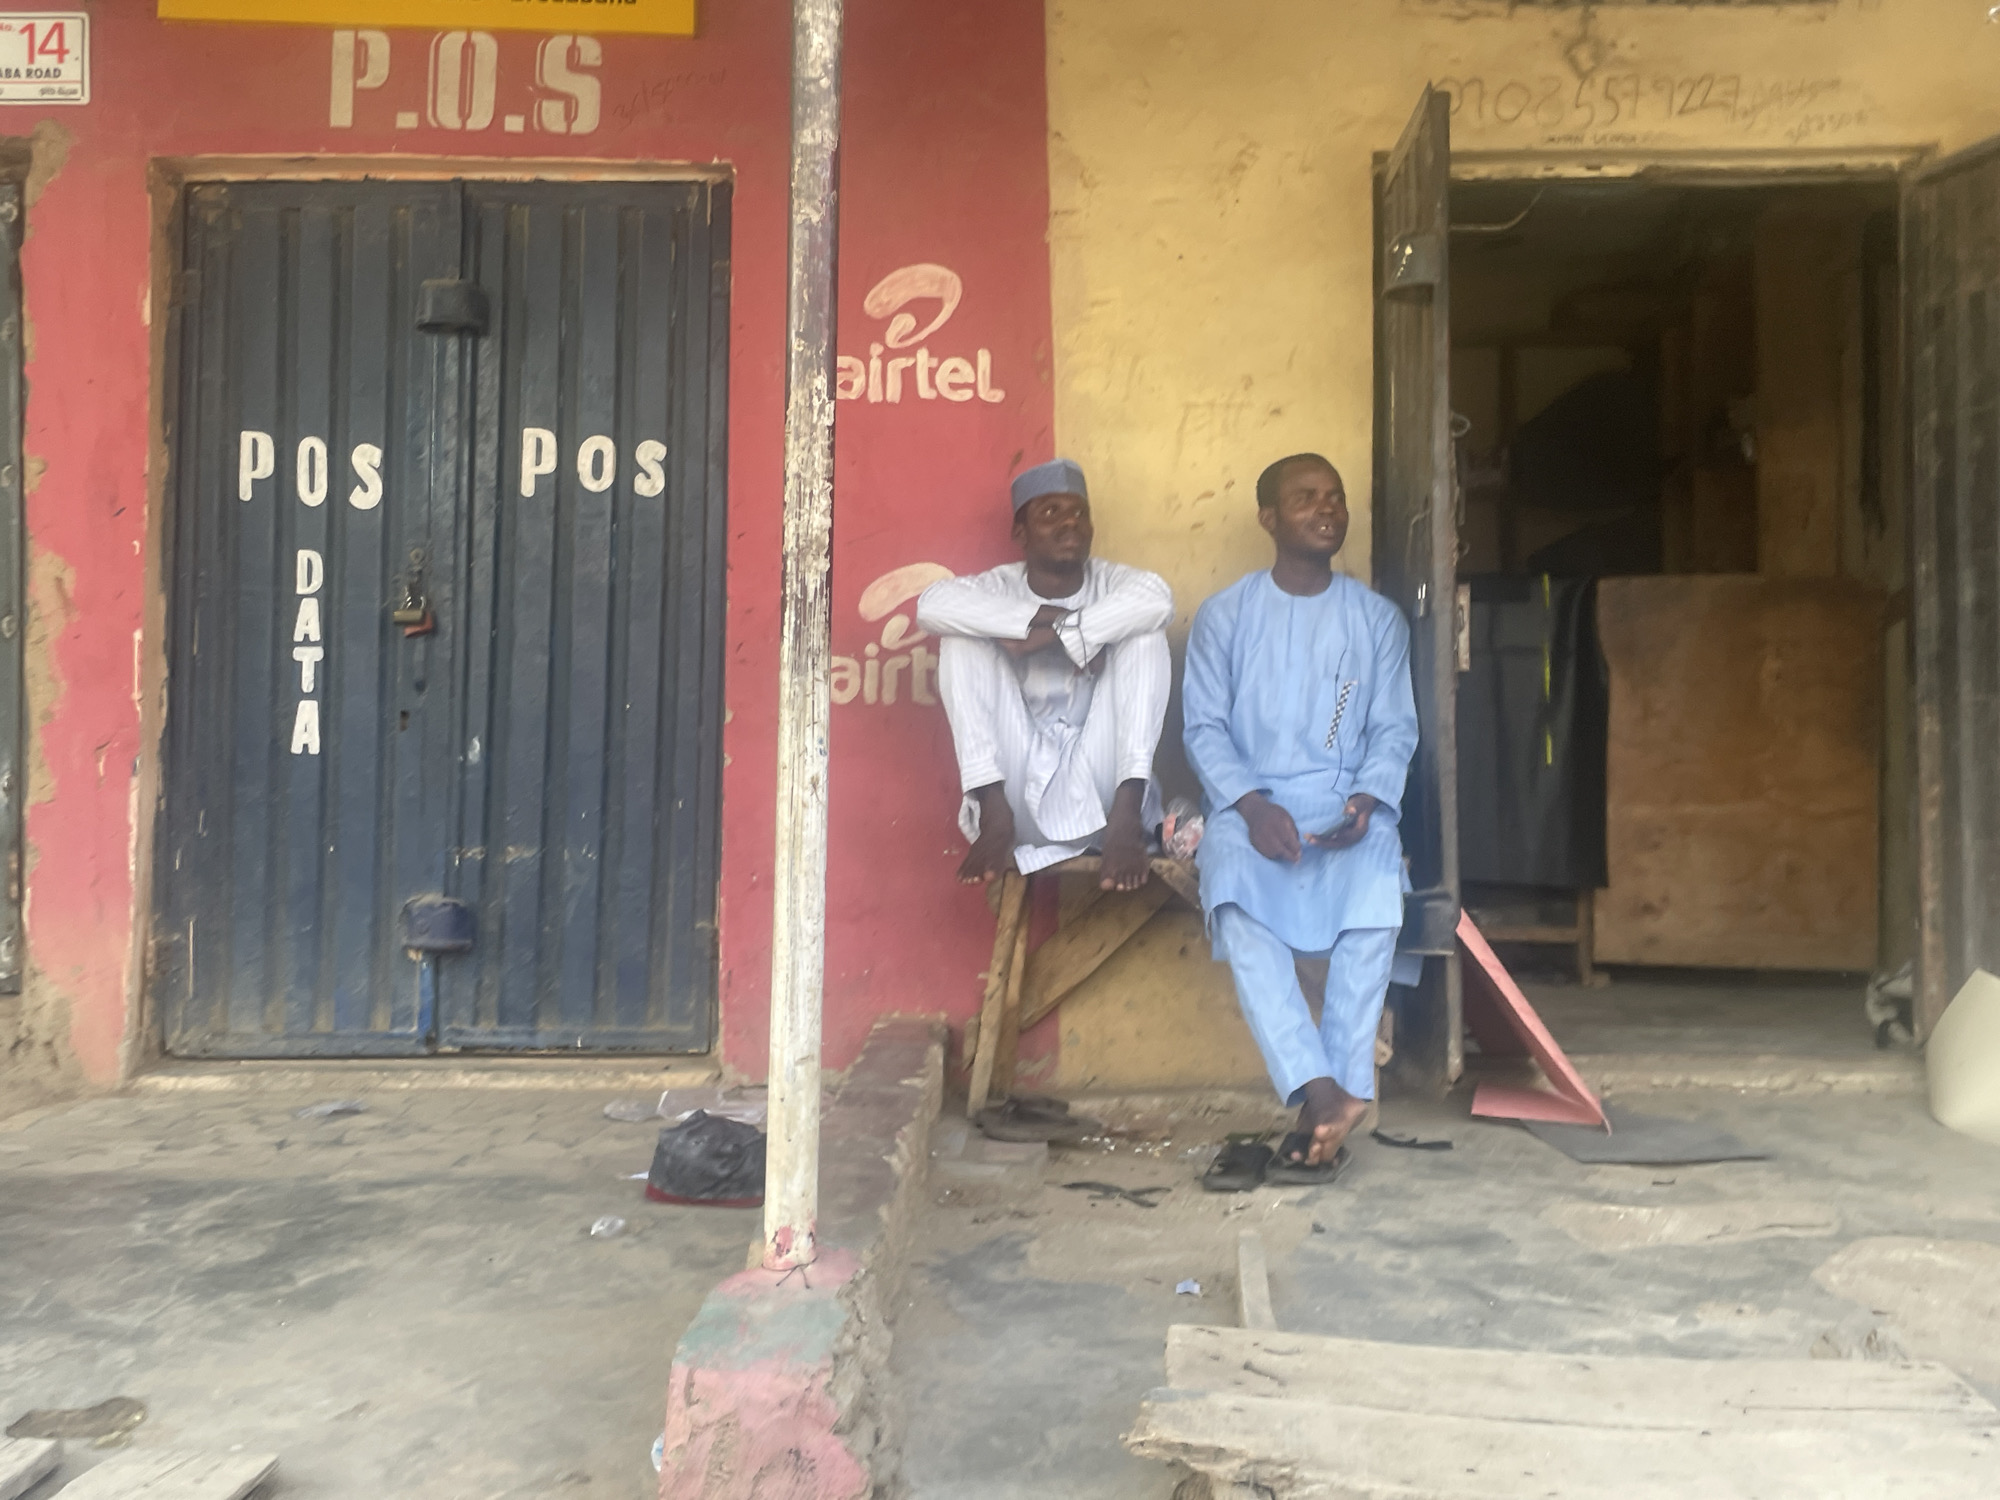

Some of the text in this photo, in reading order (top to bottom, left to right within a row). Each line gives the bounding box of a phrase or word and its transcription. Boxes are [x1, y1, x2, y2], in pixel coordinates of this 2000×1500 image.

[19, 21, 70, 65] 14
[25, 68, 62, 79] ROAD
[329, 29, 603, 136] P.O.S
[837, 342, 1006, 404] airtel
[239, 430, 383, 510] POS
[520, 427, 667, 497] POS
[290, 549, 325, 755] DATA
[830, 642, 940, 706] airt
